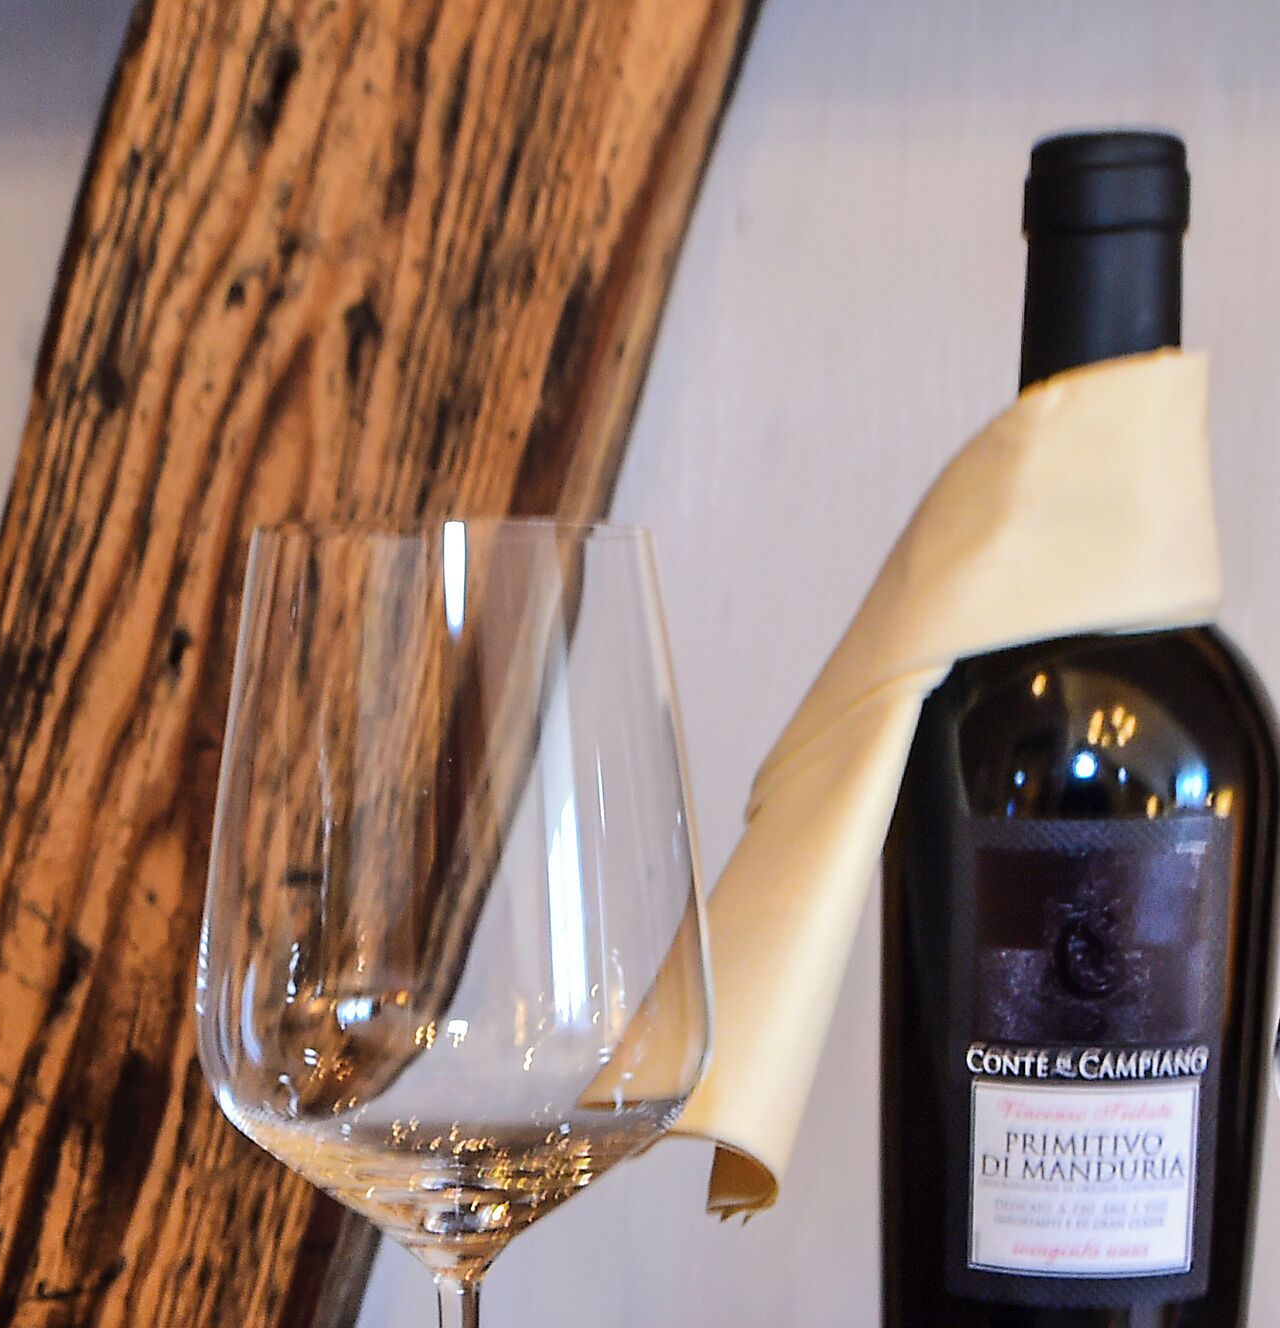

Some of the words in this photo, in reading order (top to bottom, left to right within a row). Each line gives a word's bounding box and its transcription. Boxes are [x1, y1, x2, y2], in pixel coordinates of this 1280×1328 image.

[966, 1045, 1049, 1079] CONTE
[1078, 1046, 1209, 1080] CAMPIANO
[1006, 1129, 1163, 1157] PRIMITIVO
[981, 1154, 1009, 1178] DI
[1022, 1153, 1185, 1182] MANDURIA
